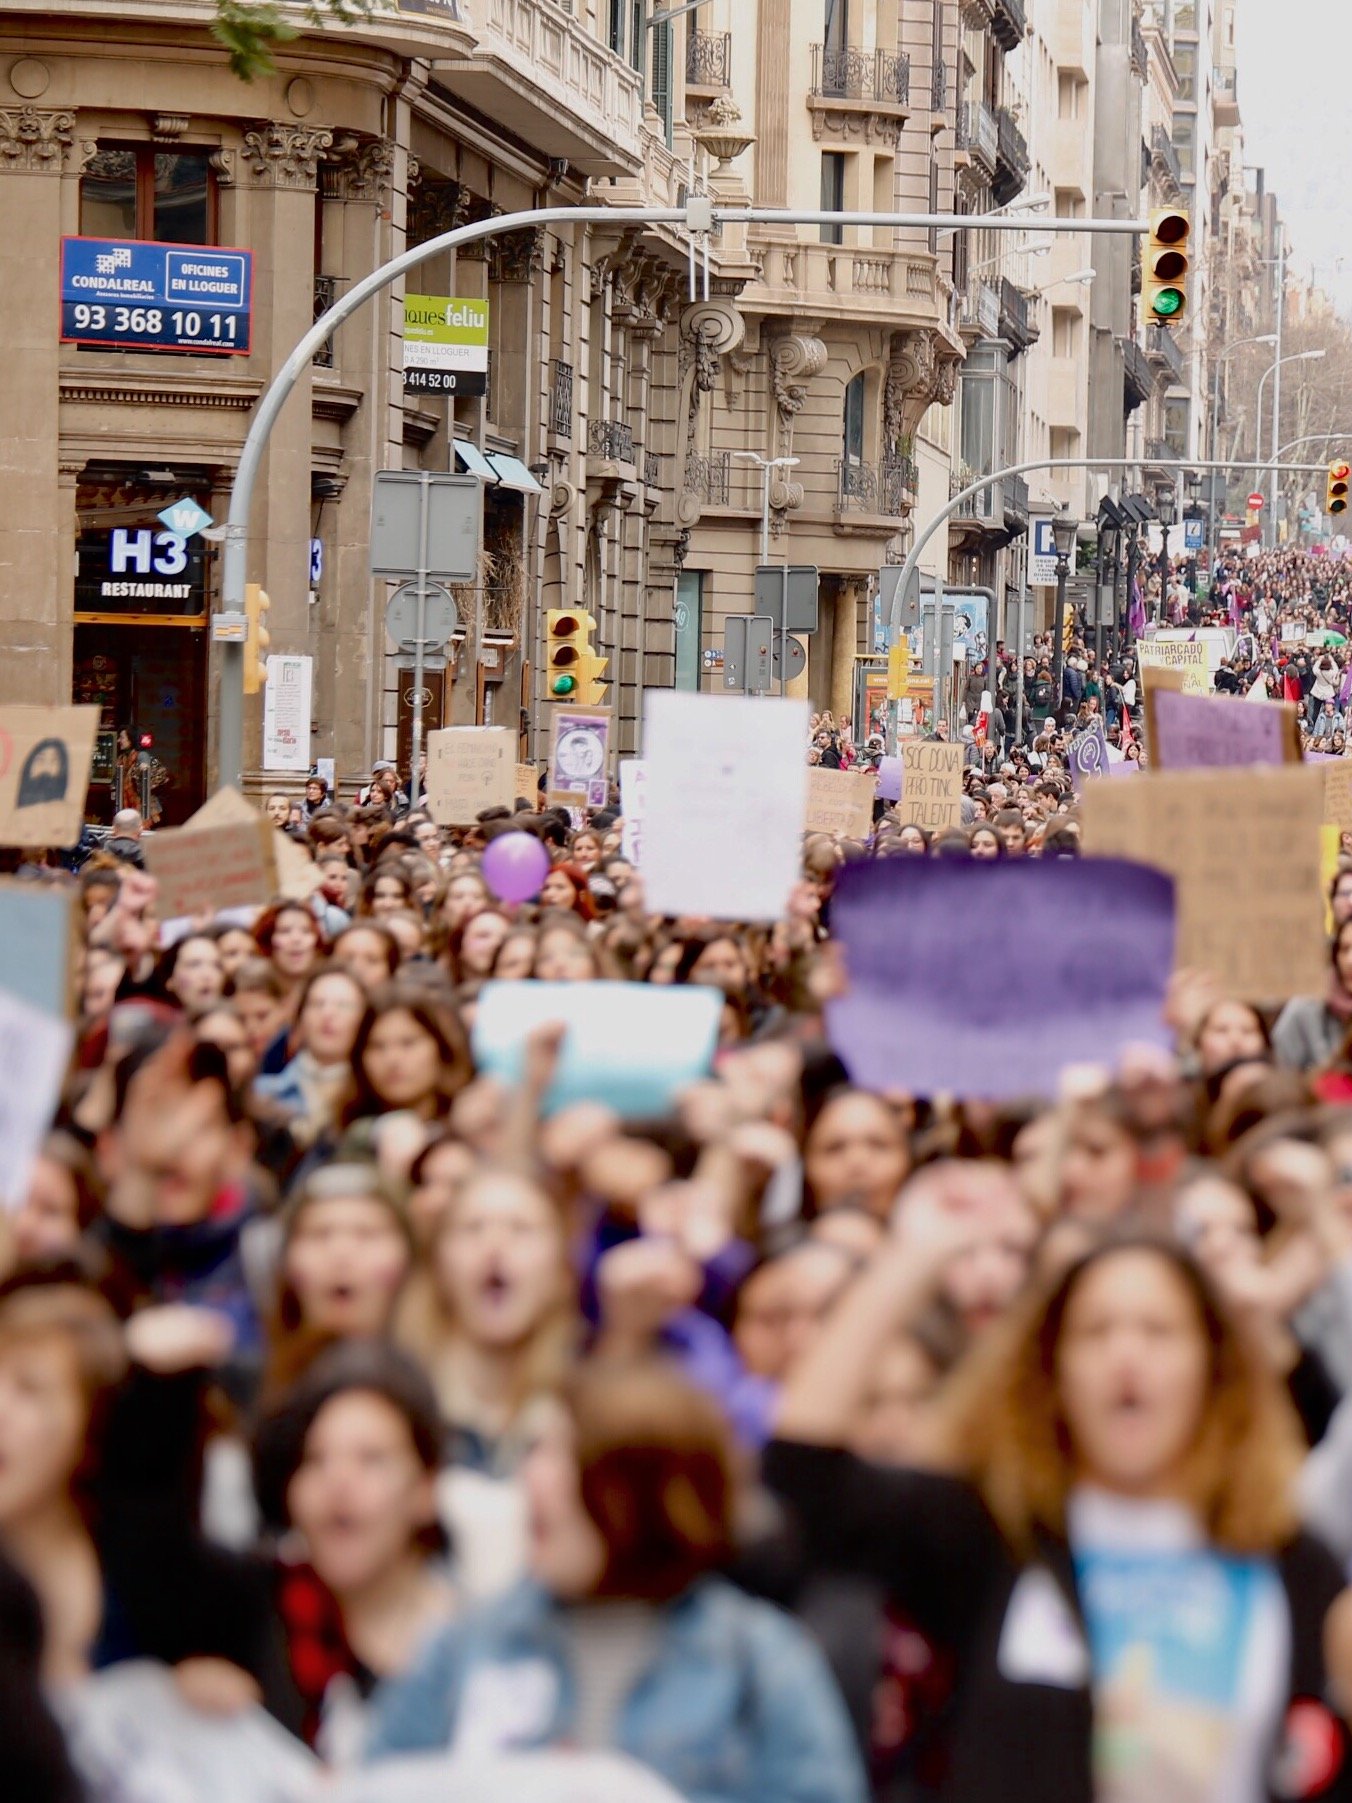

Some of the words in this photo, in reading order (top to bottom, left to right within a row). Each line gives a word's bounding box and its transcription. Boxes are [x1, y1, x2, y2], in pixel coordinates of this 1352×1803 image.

[181, 263, 229, 278] OFICINES
[72, 275, 155, 293] CONDALREAL
[172, 278, 186, 290] EN
[188, 279, 238, 294] LLOGUER
[74, 304, 106, 330] 93
[114, 307, 162, 334] 368
[171, 311, 201, 336] 10
[210, 314, 236, 339] 11
[420, 345, 431, 354] EN
[432, 347, 470, 357] LLOGUER
[409, 371, 426, 386] 414
[428, 373, 441, 388] 52
[443, 375, 456, 389] 00
[110, 528, 188, 576] H3
[102, 581, 192, 599] RESTAURANT
[1140, 643, 1203, 656] PATRIARCADO
[1165, 655, 1204, 666] CAPITAL
[931, 777, 952, 798] TINC
[908, 801, 958, 826] TALENT
